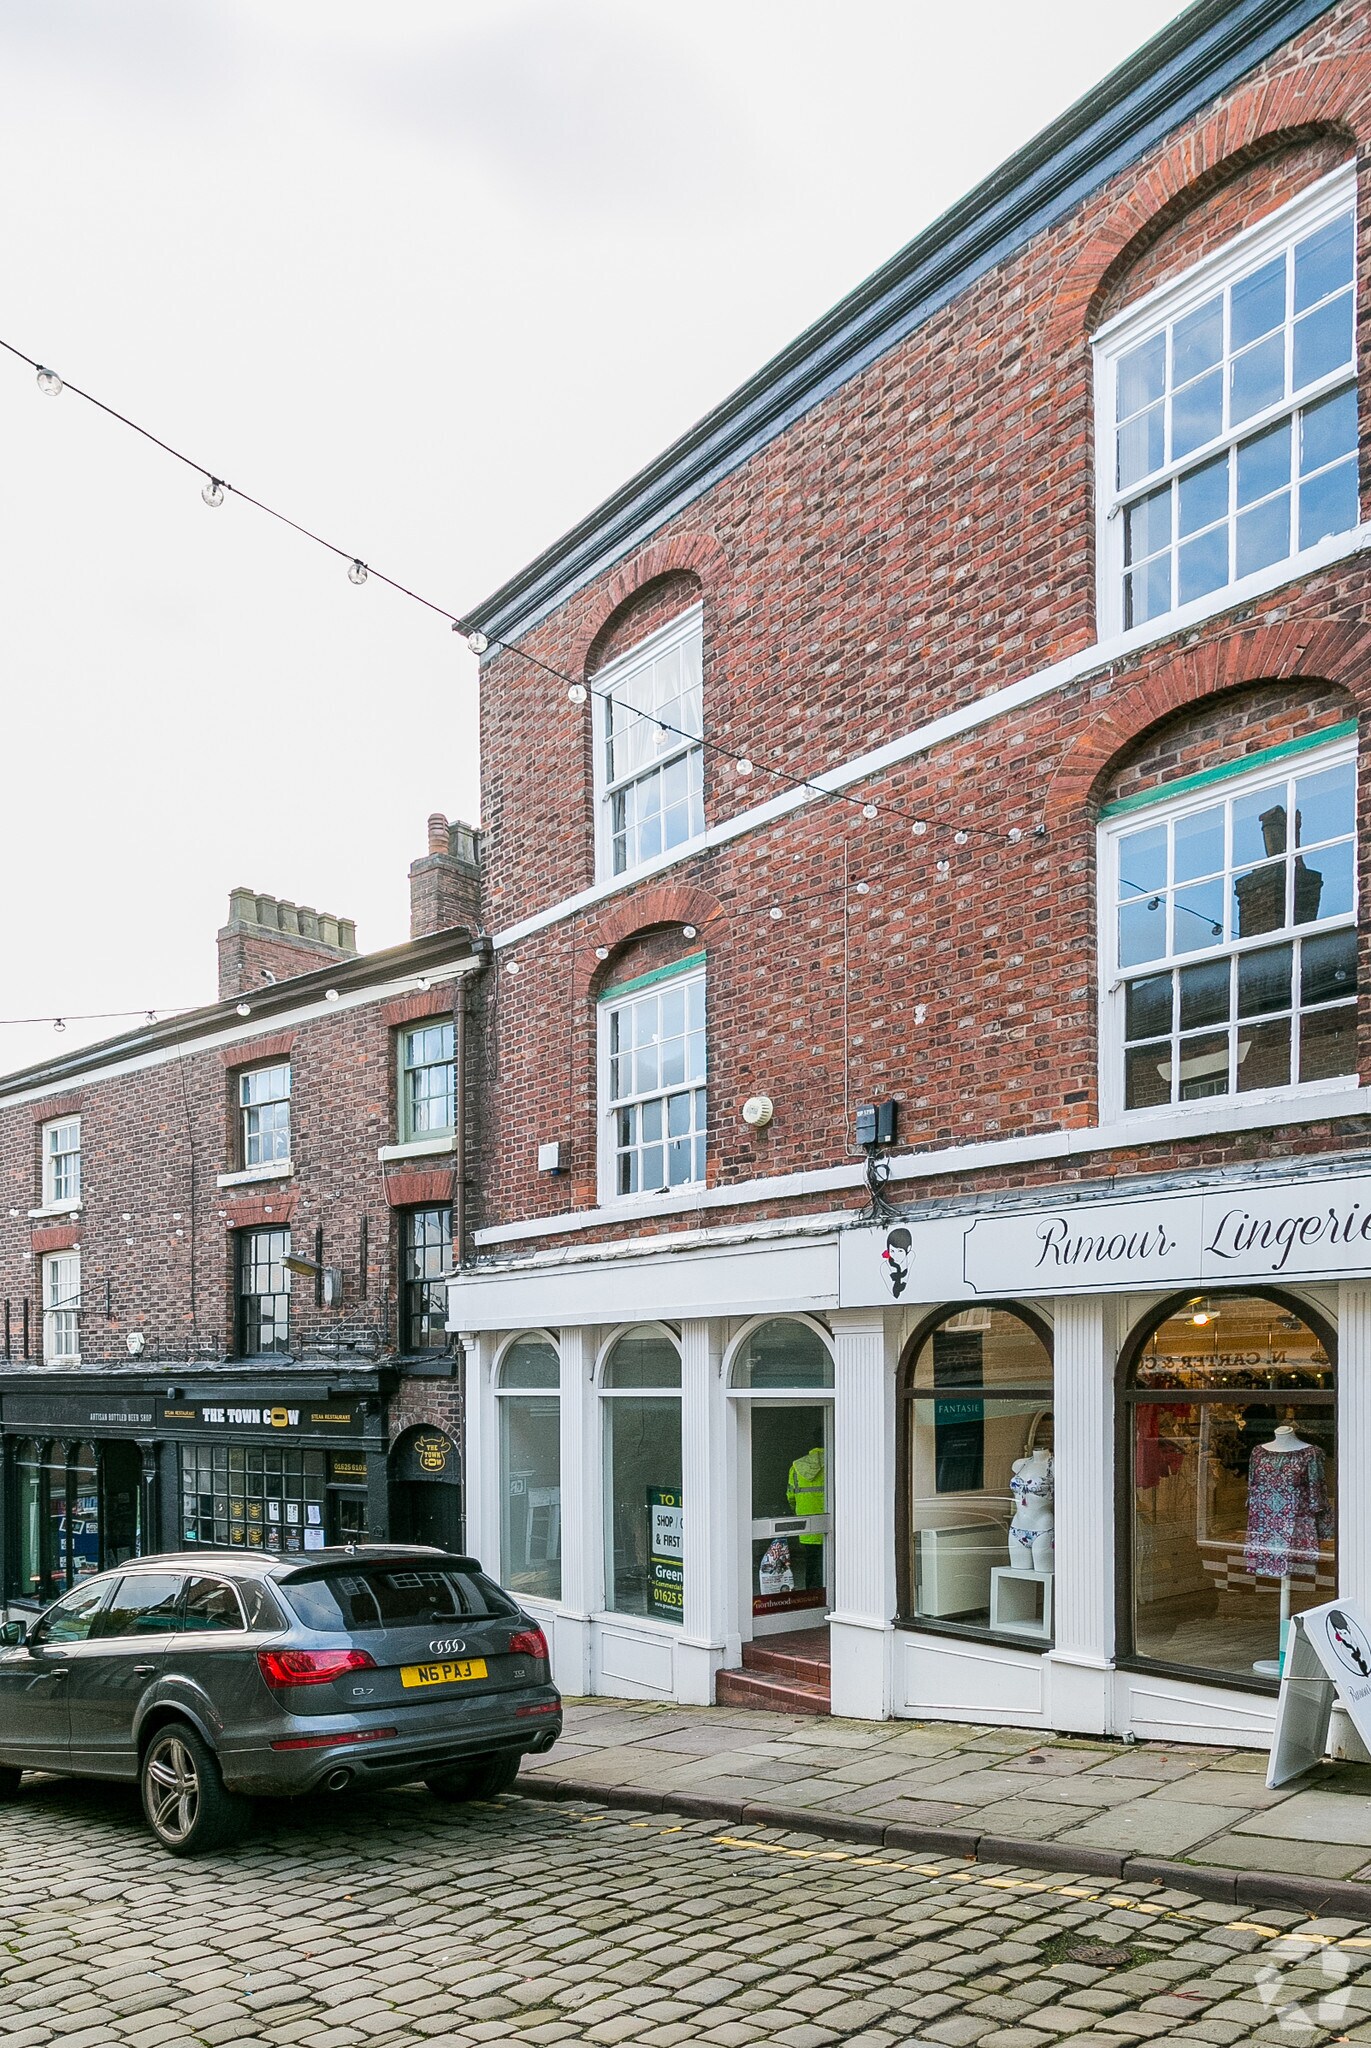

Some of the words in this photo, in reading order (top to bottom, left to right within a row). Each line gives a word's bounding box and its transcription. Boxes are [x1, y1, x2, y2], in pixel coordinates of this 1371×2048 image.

[1203, 1203, 1371, 1270] Lingerie
[938, 1404, 980, 1414] FANTASIE
[89, 1412, 108, 1421] ARTISAN
[108, 1413, 127, 1421] BOTTLED
[140, 1413, 152, 1422] SHOP
[202, 1408, 225, 1422] THE
[227, 1408, 261, 1424] TOWN
[262, 1407, 300, 1427] COW
[424, 1458, 442, 1466] COW
[659, 1494, 675, 1506] TO
[656, 1514, 674, 1528] SHOP
[656, 1533, 661, 1545] &
[663, 1534, 680, 1548] FIRST
[655, 1564, 683, 1582] Green
[655, 1580, 682, 1591] Commercial
[653, 1588, 677, 1605] 01625
[417, 1667, 440, 1683] N6
[441, 1662, 472, 1680] PAJ
[352, 1687, 374, 1696] Q7
